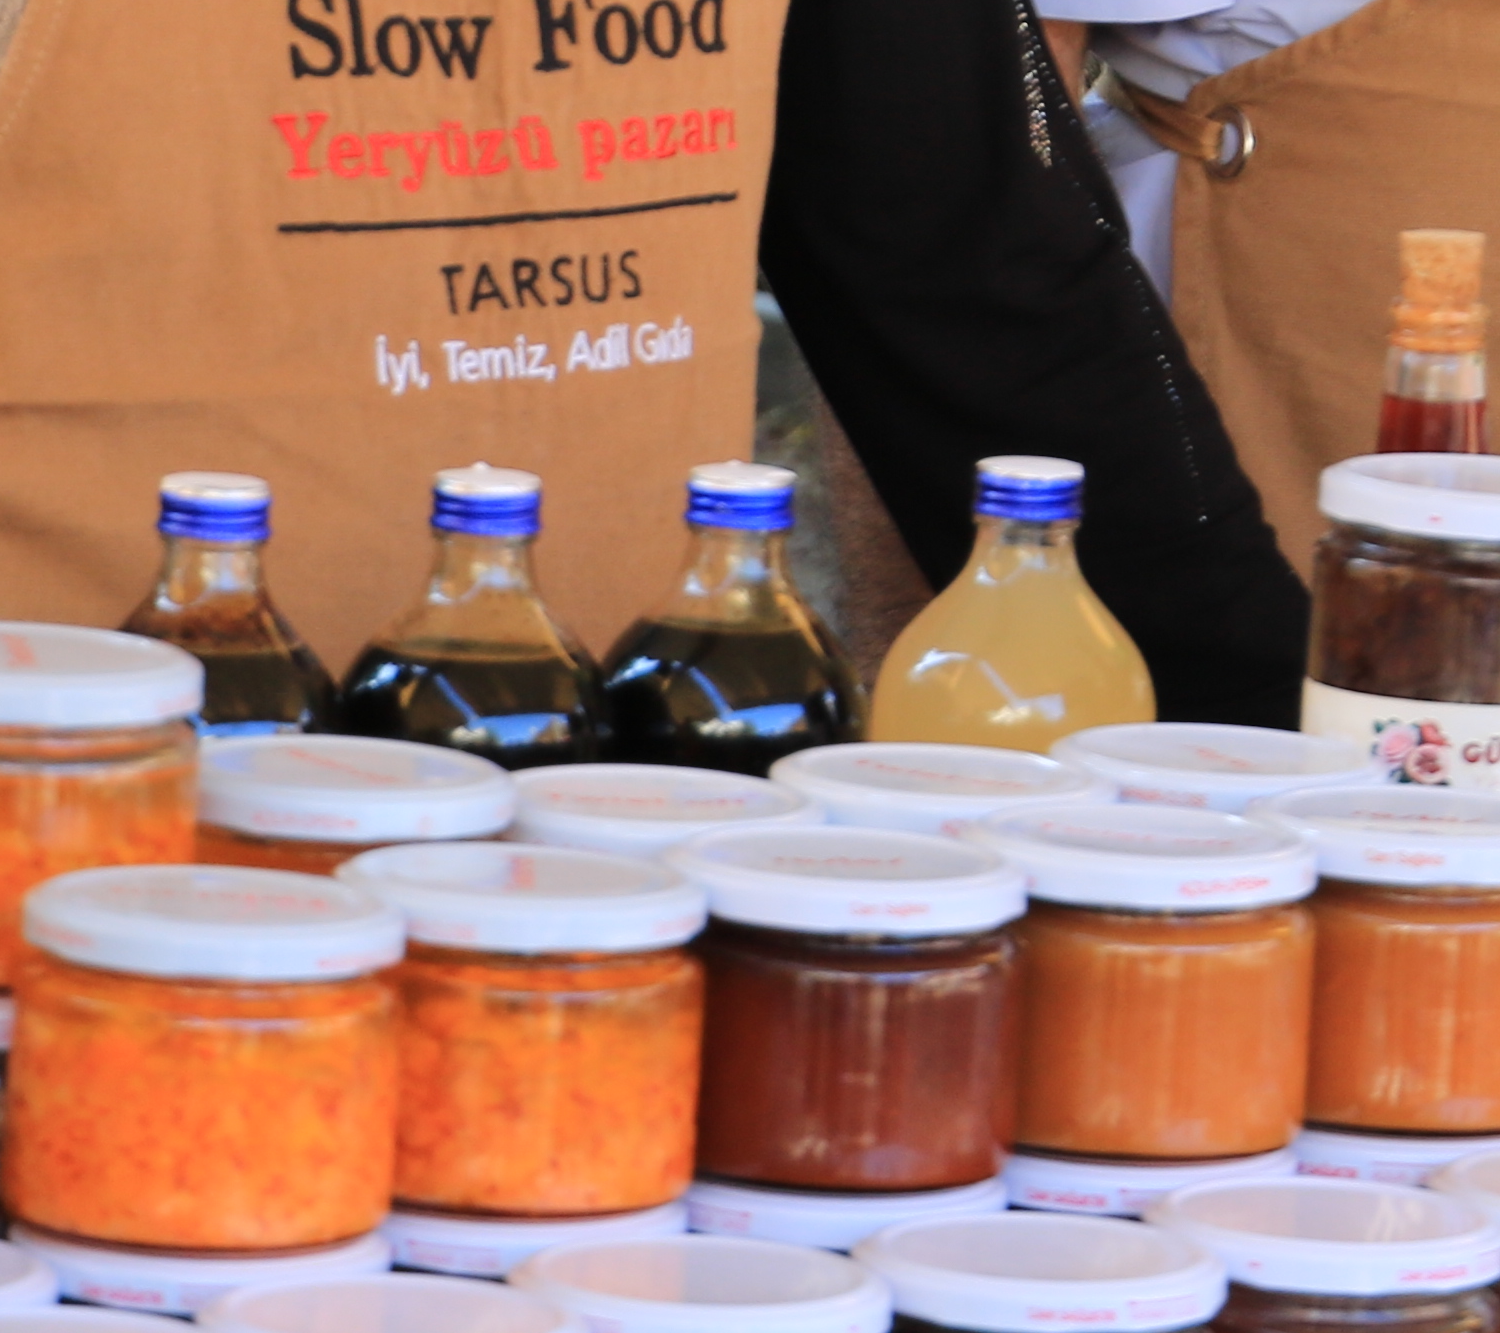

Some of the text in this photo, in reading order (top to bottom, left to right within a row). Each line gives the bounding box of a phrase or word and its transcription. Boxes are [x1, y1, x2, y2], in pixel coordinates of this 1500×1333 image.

[272, 107, 737, 193] Yeryüzü pazarı
[439, 250, 642, 316] TARSUS
[440, 334, 556, 384] Temiz,
